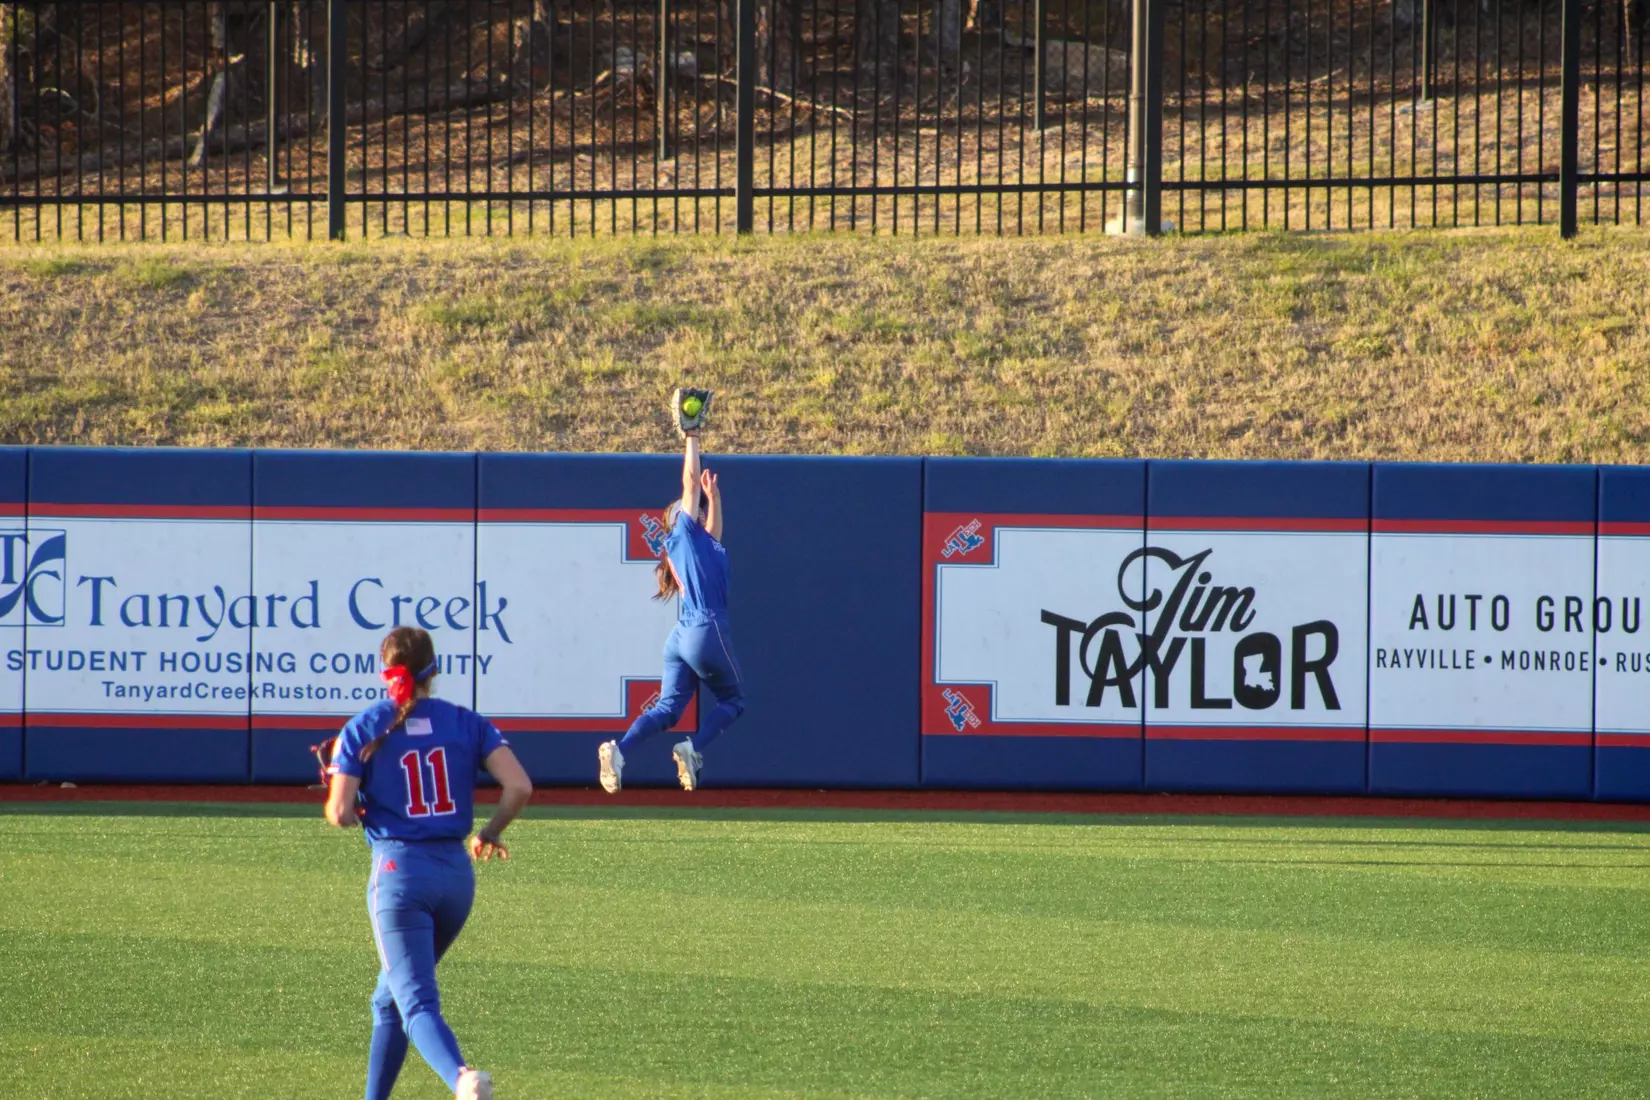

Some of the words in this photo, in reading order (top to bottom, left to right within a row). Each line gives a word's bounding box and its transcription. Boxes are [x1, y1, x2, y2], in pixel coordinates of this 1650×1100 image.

[76, 575, 321, 643] Tanyard
[348, 577, 514, 644] Creek
[1117, 546, 1257, 648] Jim
[1408, 593, 1511, 632] AUTO
[1536, 594, 1641, 634] GROU
[6, 649, 147, 672] STUDENT
[160, 651, 297, 674] HOUSING
[309, 652, 493, 676] COMITY
[1040, 608, 1342, 711] TAYLOR
[1376, 648, 1476, 669] RAYVILLE
[1501, 650, 1589, 671] MONROE
[400, 746, 456, 818] 11
